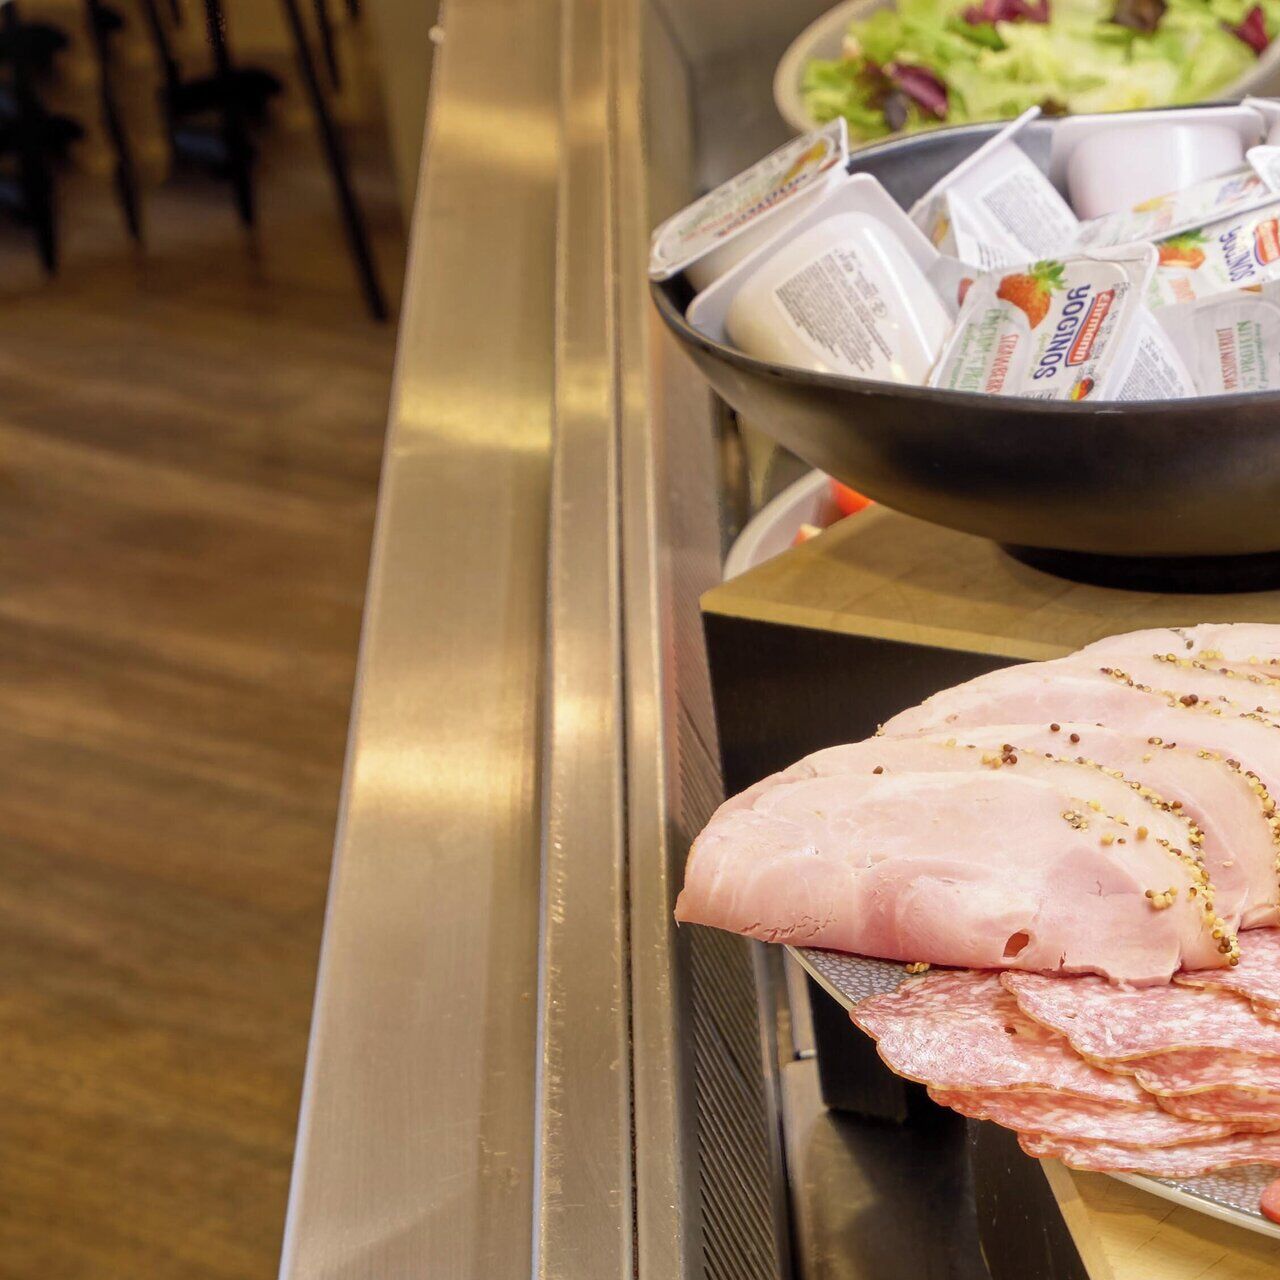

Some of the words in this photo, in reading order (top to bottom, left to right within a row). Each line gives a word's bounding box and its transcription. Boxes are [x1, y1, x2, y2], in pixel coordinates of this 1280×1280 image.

[1033, 284, 1092, 381] YOGINOS
[1072, 292, 1110, 362] Ehrmann
[1236, 318, 1258, 374] PROTEIN
